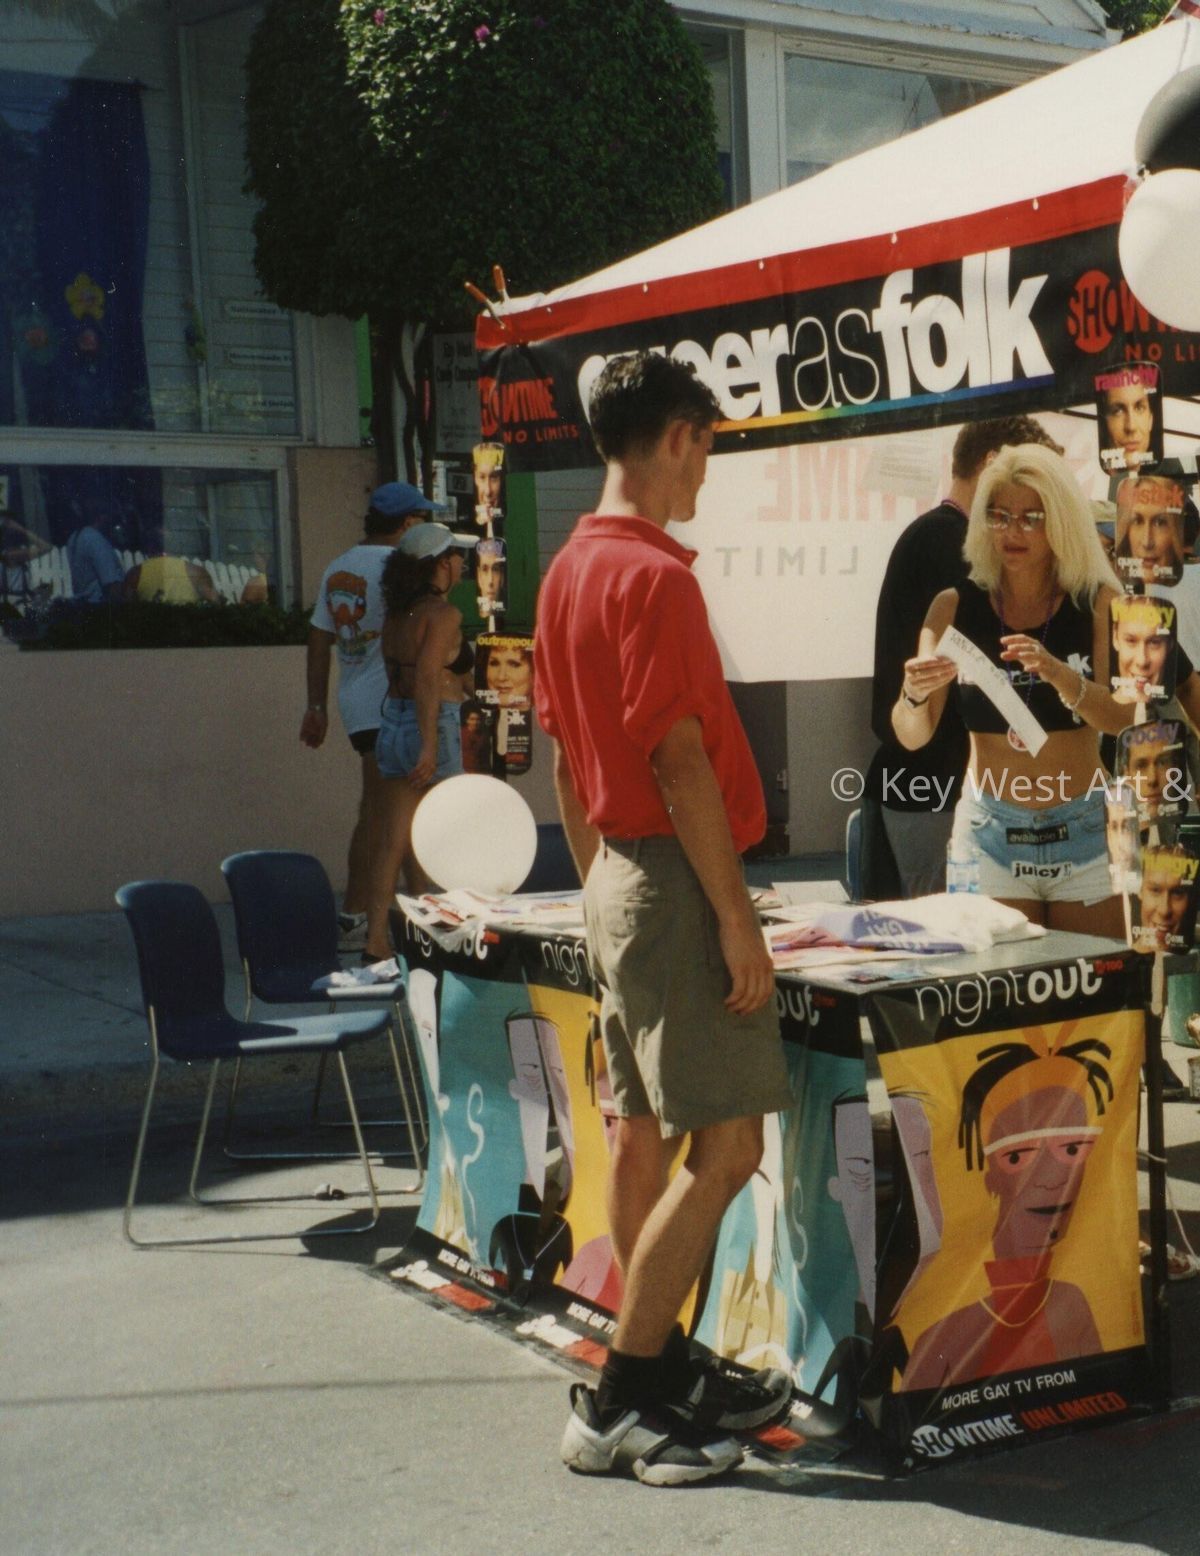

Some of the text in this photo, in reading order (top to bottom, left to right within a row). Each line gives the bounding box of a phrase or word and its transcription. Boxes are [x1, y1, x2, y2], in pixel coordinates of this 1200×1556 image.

[1125, 343, 1163, 361] NO
[503, 423, 578, 444] NO LIMITS
[477, 635, 535, 650] outrageou
[941, 1369, 1077, 1410] MORE GAY TV FROM
[911, 1391, 1128, 1458] SHOWTIME UNLIMITED
